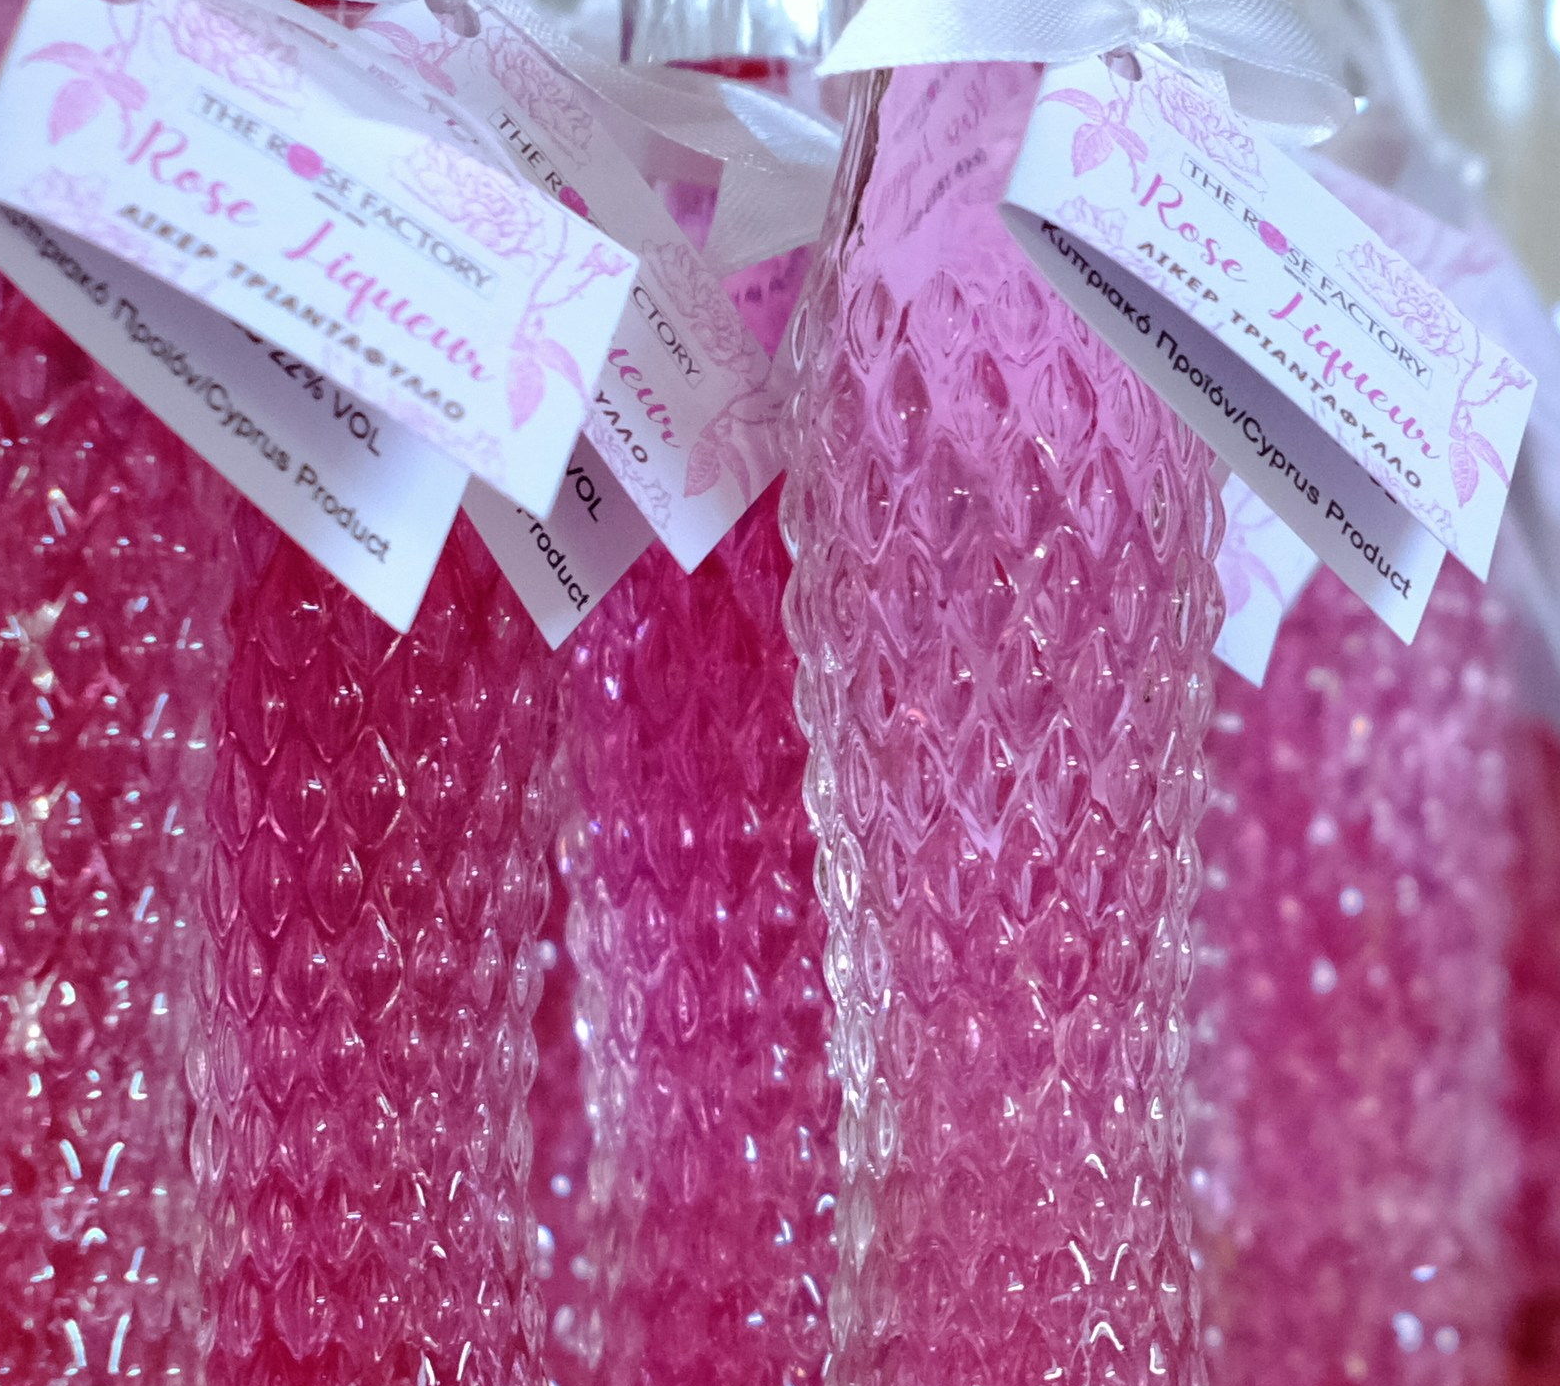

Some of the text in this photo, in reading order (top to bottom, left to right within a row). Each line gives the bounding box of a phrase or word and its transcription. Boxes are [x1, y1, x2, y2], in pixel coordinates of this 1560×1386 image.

[126, 120, 496, 381] Rose Liqueur
[200, 93, 260, 138] THE
[359, 192, 492, 289] FACTORY
[499, 113, 545, 168] THE
[633, 286, 701, 377] CTORY
[1188, 159, 1237, 212] THE
[1320, 276, 1428, 377] FACTORY
[1139, 173, 1247, 282] Rose
[1268, 292, 1440, 459] Liqueur
[294, 462, 392, 565] Product
[334, 390, 381, 457] VOL
[517, 508, 590, 612] roduct
[1325, 499, 1412, 600] Product
